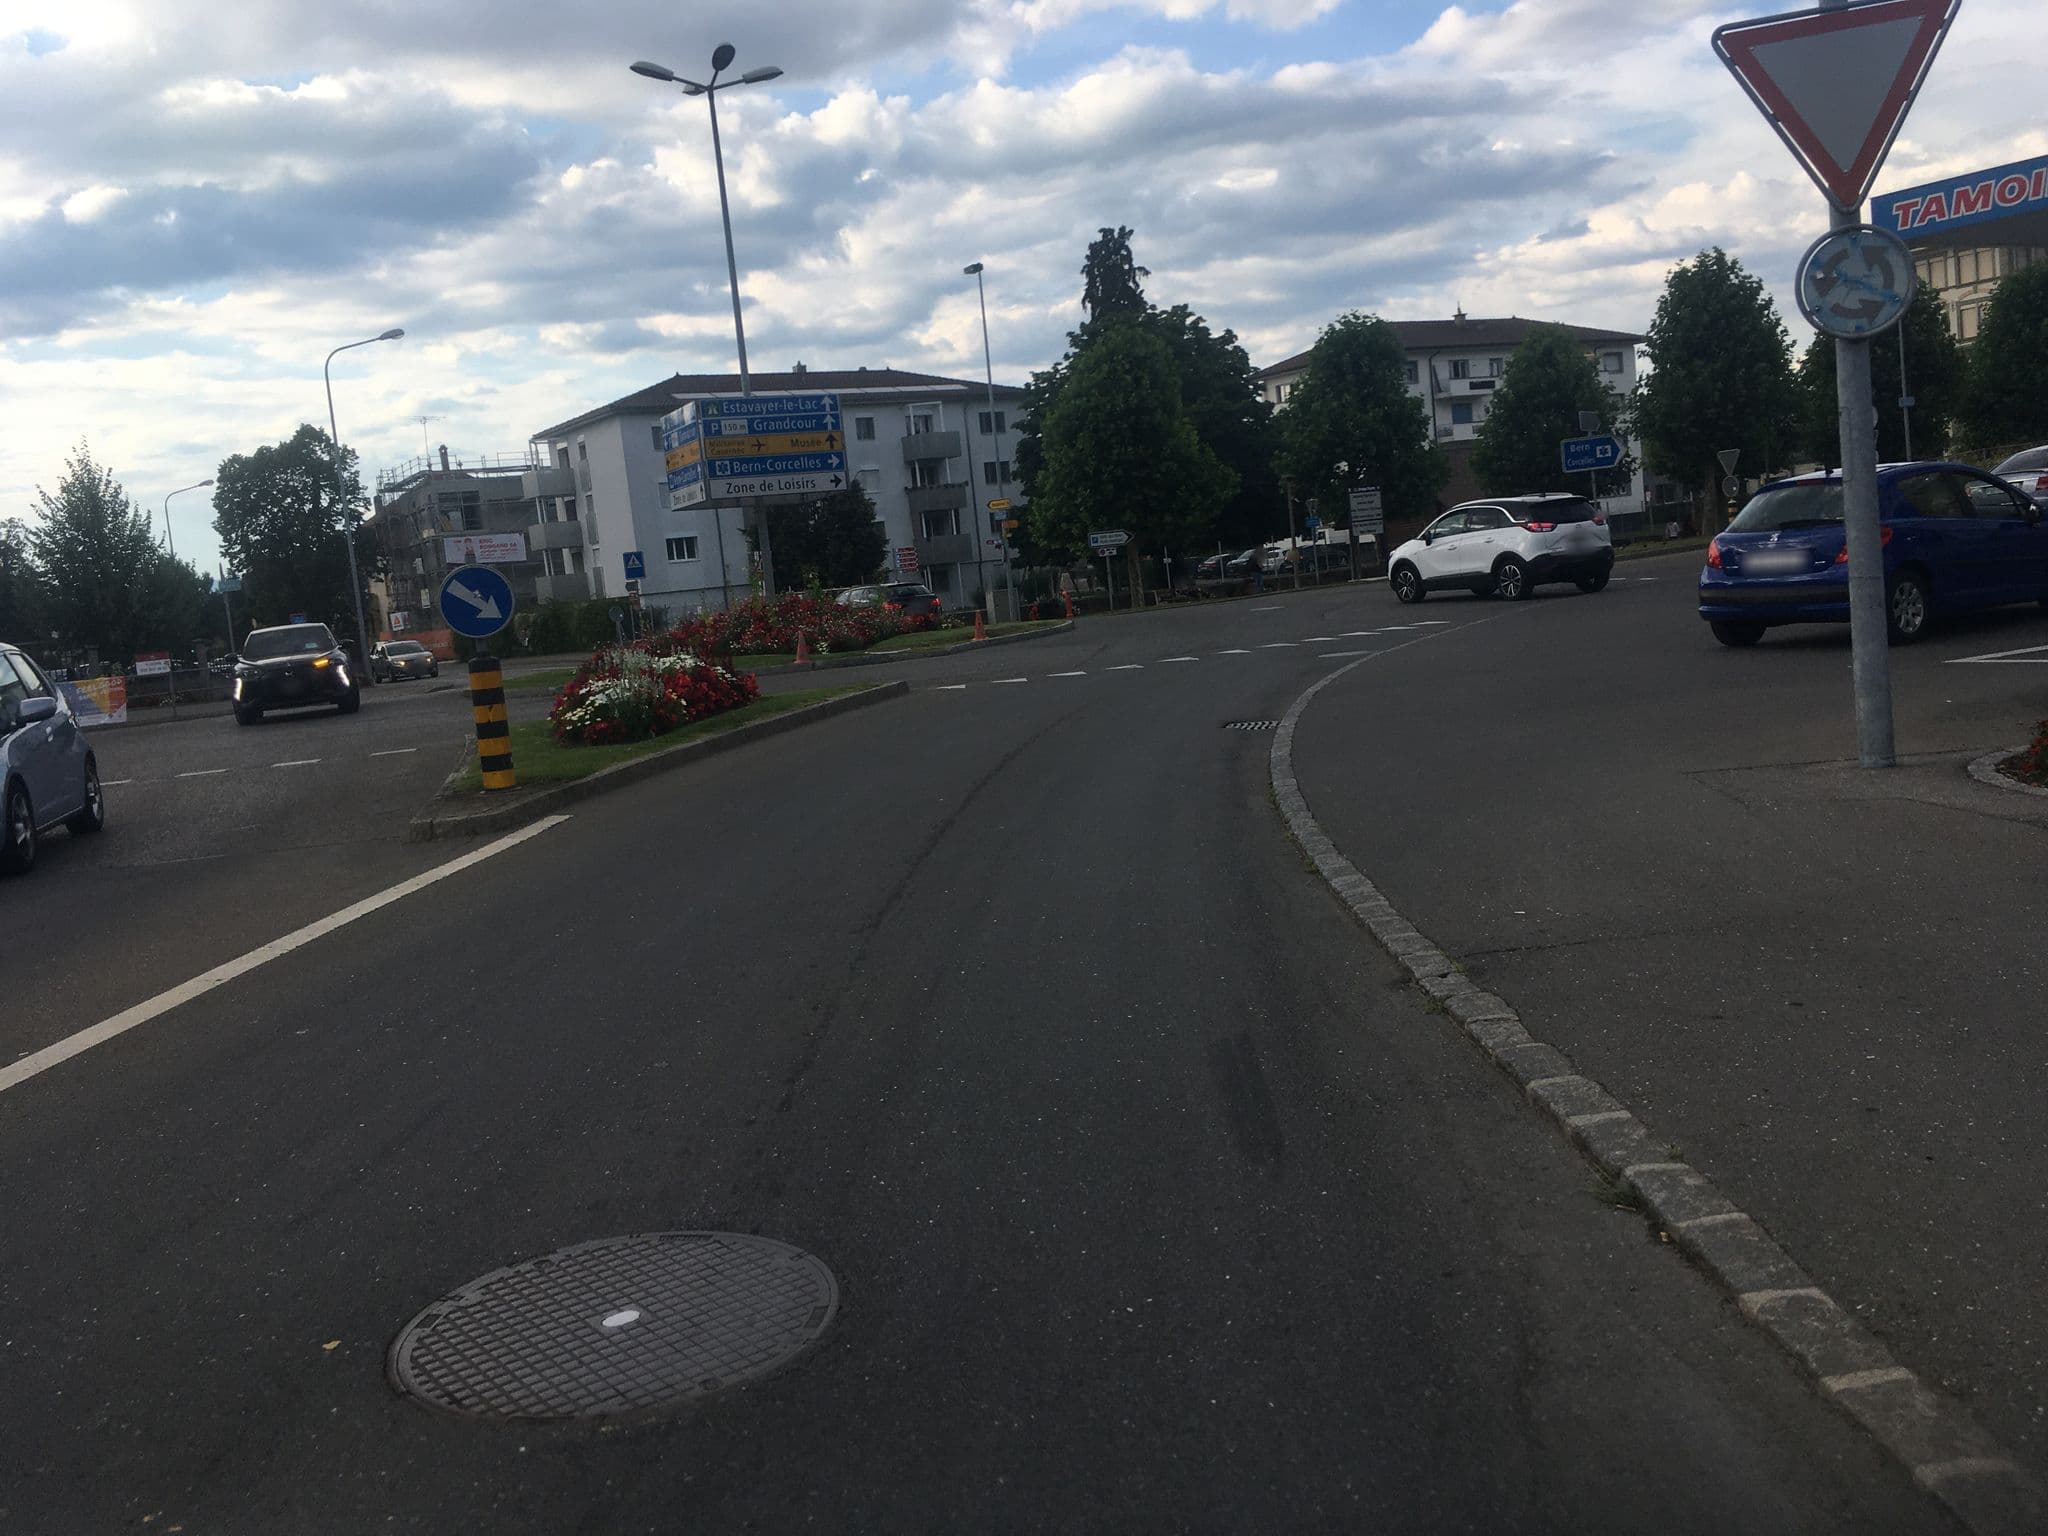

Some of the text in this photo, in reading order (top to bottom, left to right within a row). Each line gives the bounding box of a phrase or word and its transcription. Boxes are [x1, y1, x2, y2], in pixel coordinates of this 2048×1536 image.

[1893, 168, 2048, 231] TAMOI
[723, 398, 818, 415] Estavayer-le-Lac
[711, 422, 719, 434] P
[753, 417, 817, 431] Grandcour
[733, 457, 822, 473] Bern-Corcelles
[726, 477, 817, 494] Zone de Loisirs
